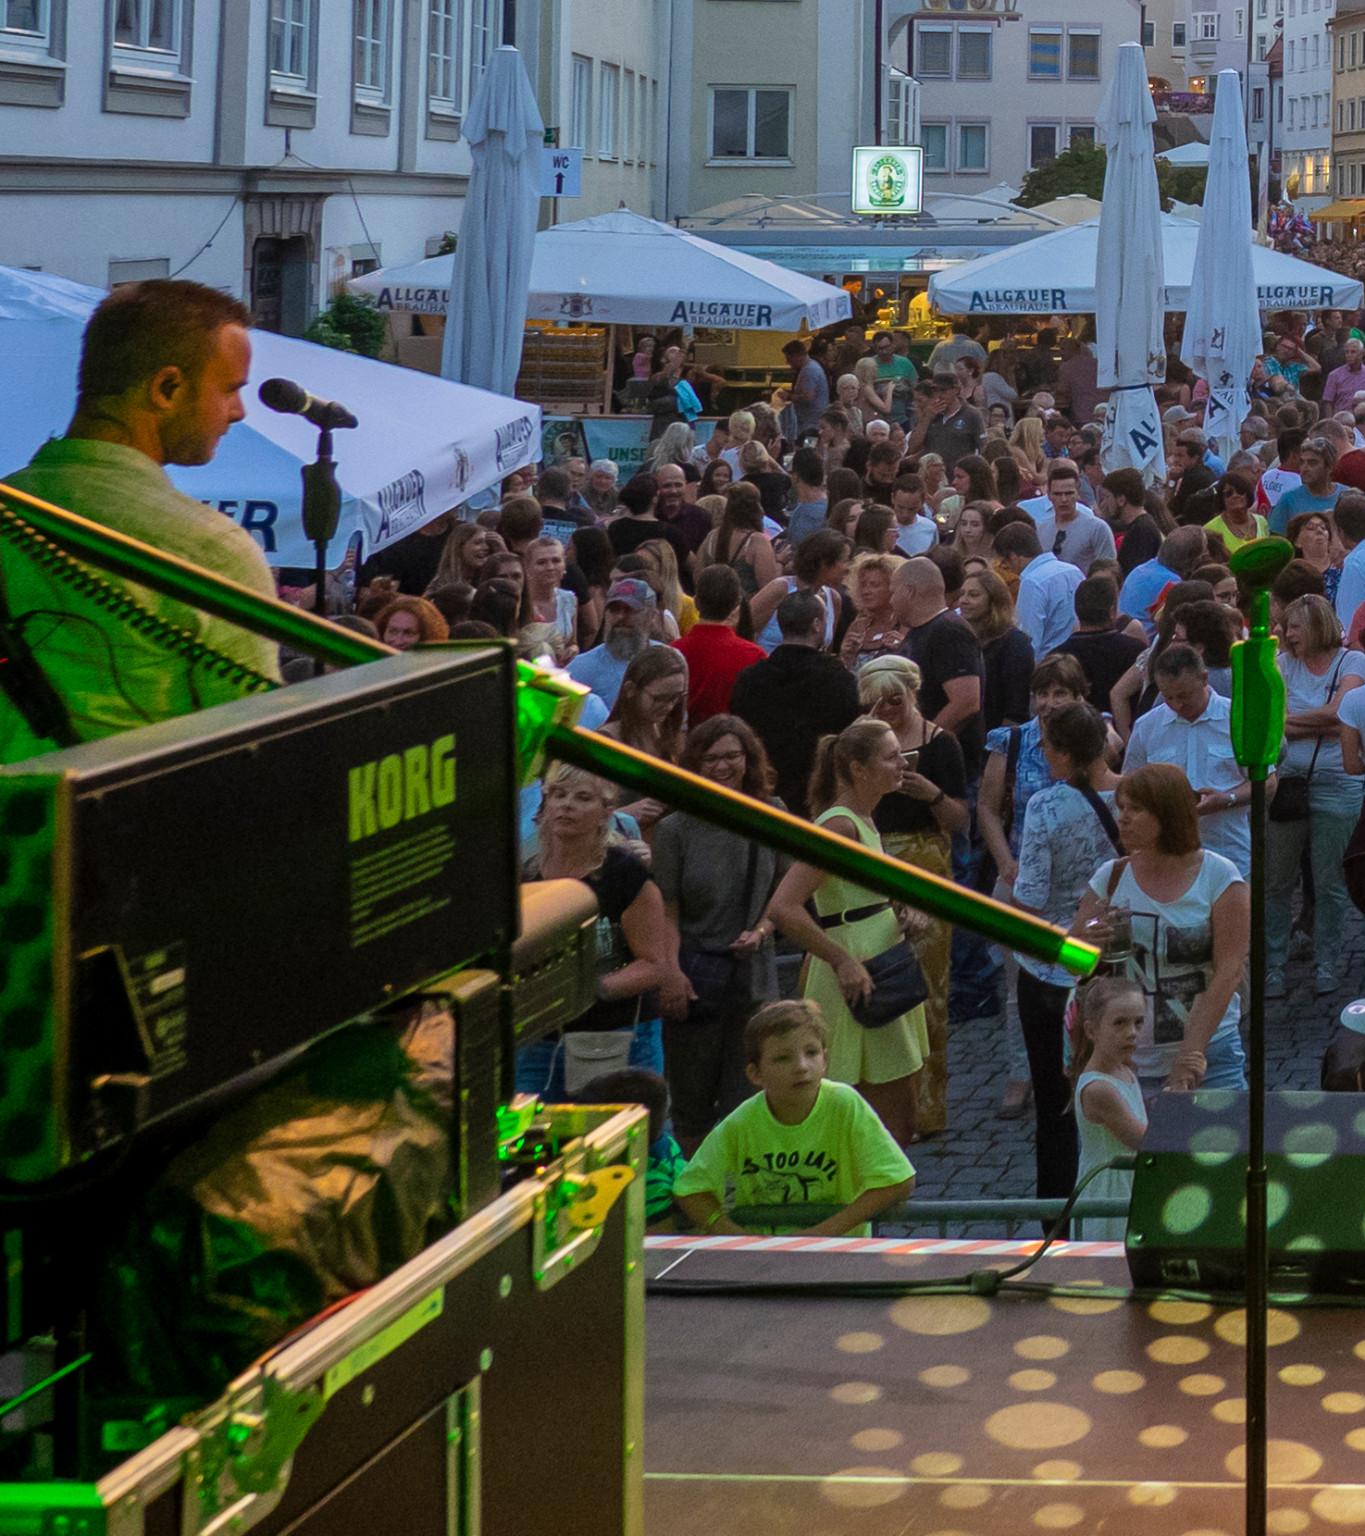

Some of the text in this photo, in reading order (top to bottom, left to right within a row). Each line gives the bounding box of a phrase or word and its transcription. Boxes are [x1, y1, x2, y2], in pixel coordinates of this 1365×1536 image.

[553, 156, 569, 169] WC
[969, 289, 1067, 312] ALLGÄUER
[670, 300, 773, 327] ALLGÄUER
[690, 316, 754, 327] BRAUHAUS
[348, 733, 456, 843] KORG
[763, 1151, 800, 1171] TOO
